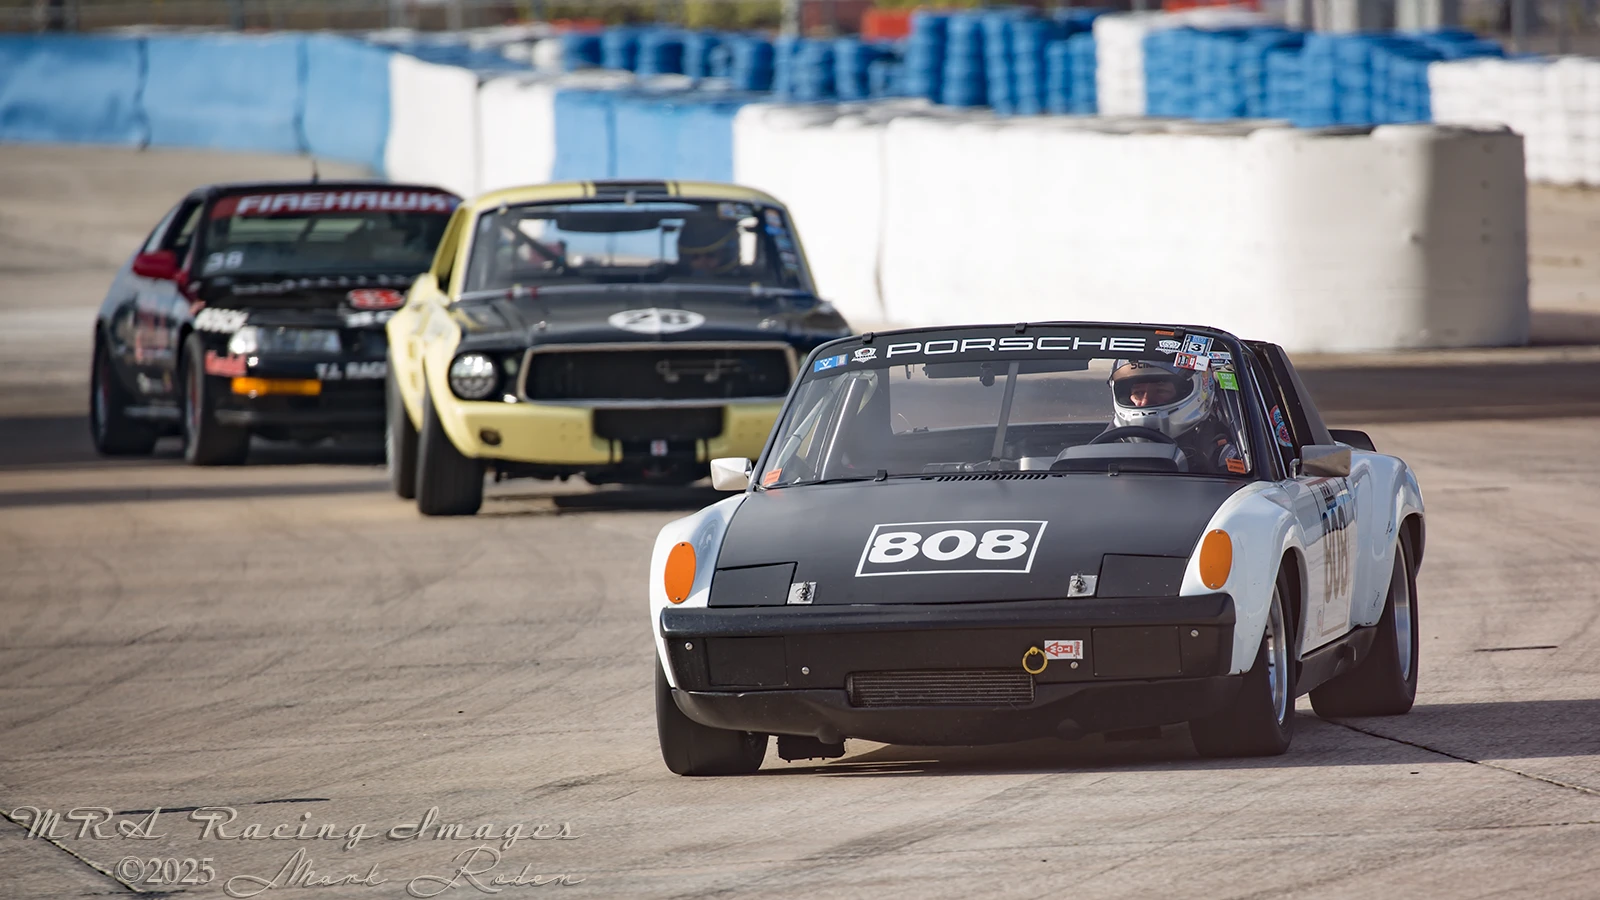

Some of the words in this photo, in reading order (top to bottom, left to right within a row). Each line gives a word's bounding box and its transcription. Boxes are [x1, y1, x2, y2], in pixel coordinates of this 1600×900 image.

[236, 191, 447, 214] FIREHAWK
[886, 336, 1146, 359] PORSCHE
[1190, 343, 1203, 352] 3
[868, 529, 1030, 564] 808
[1050, 646, 1071, 654] TOW
